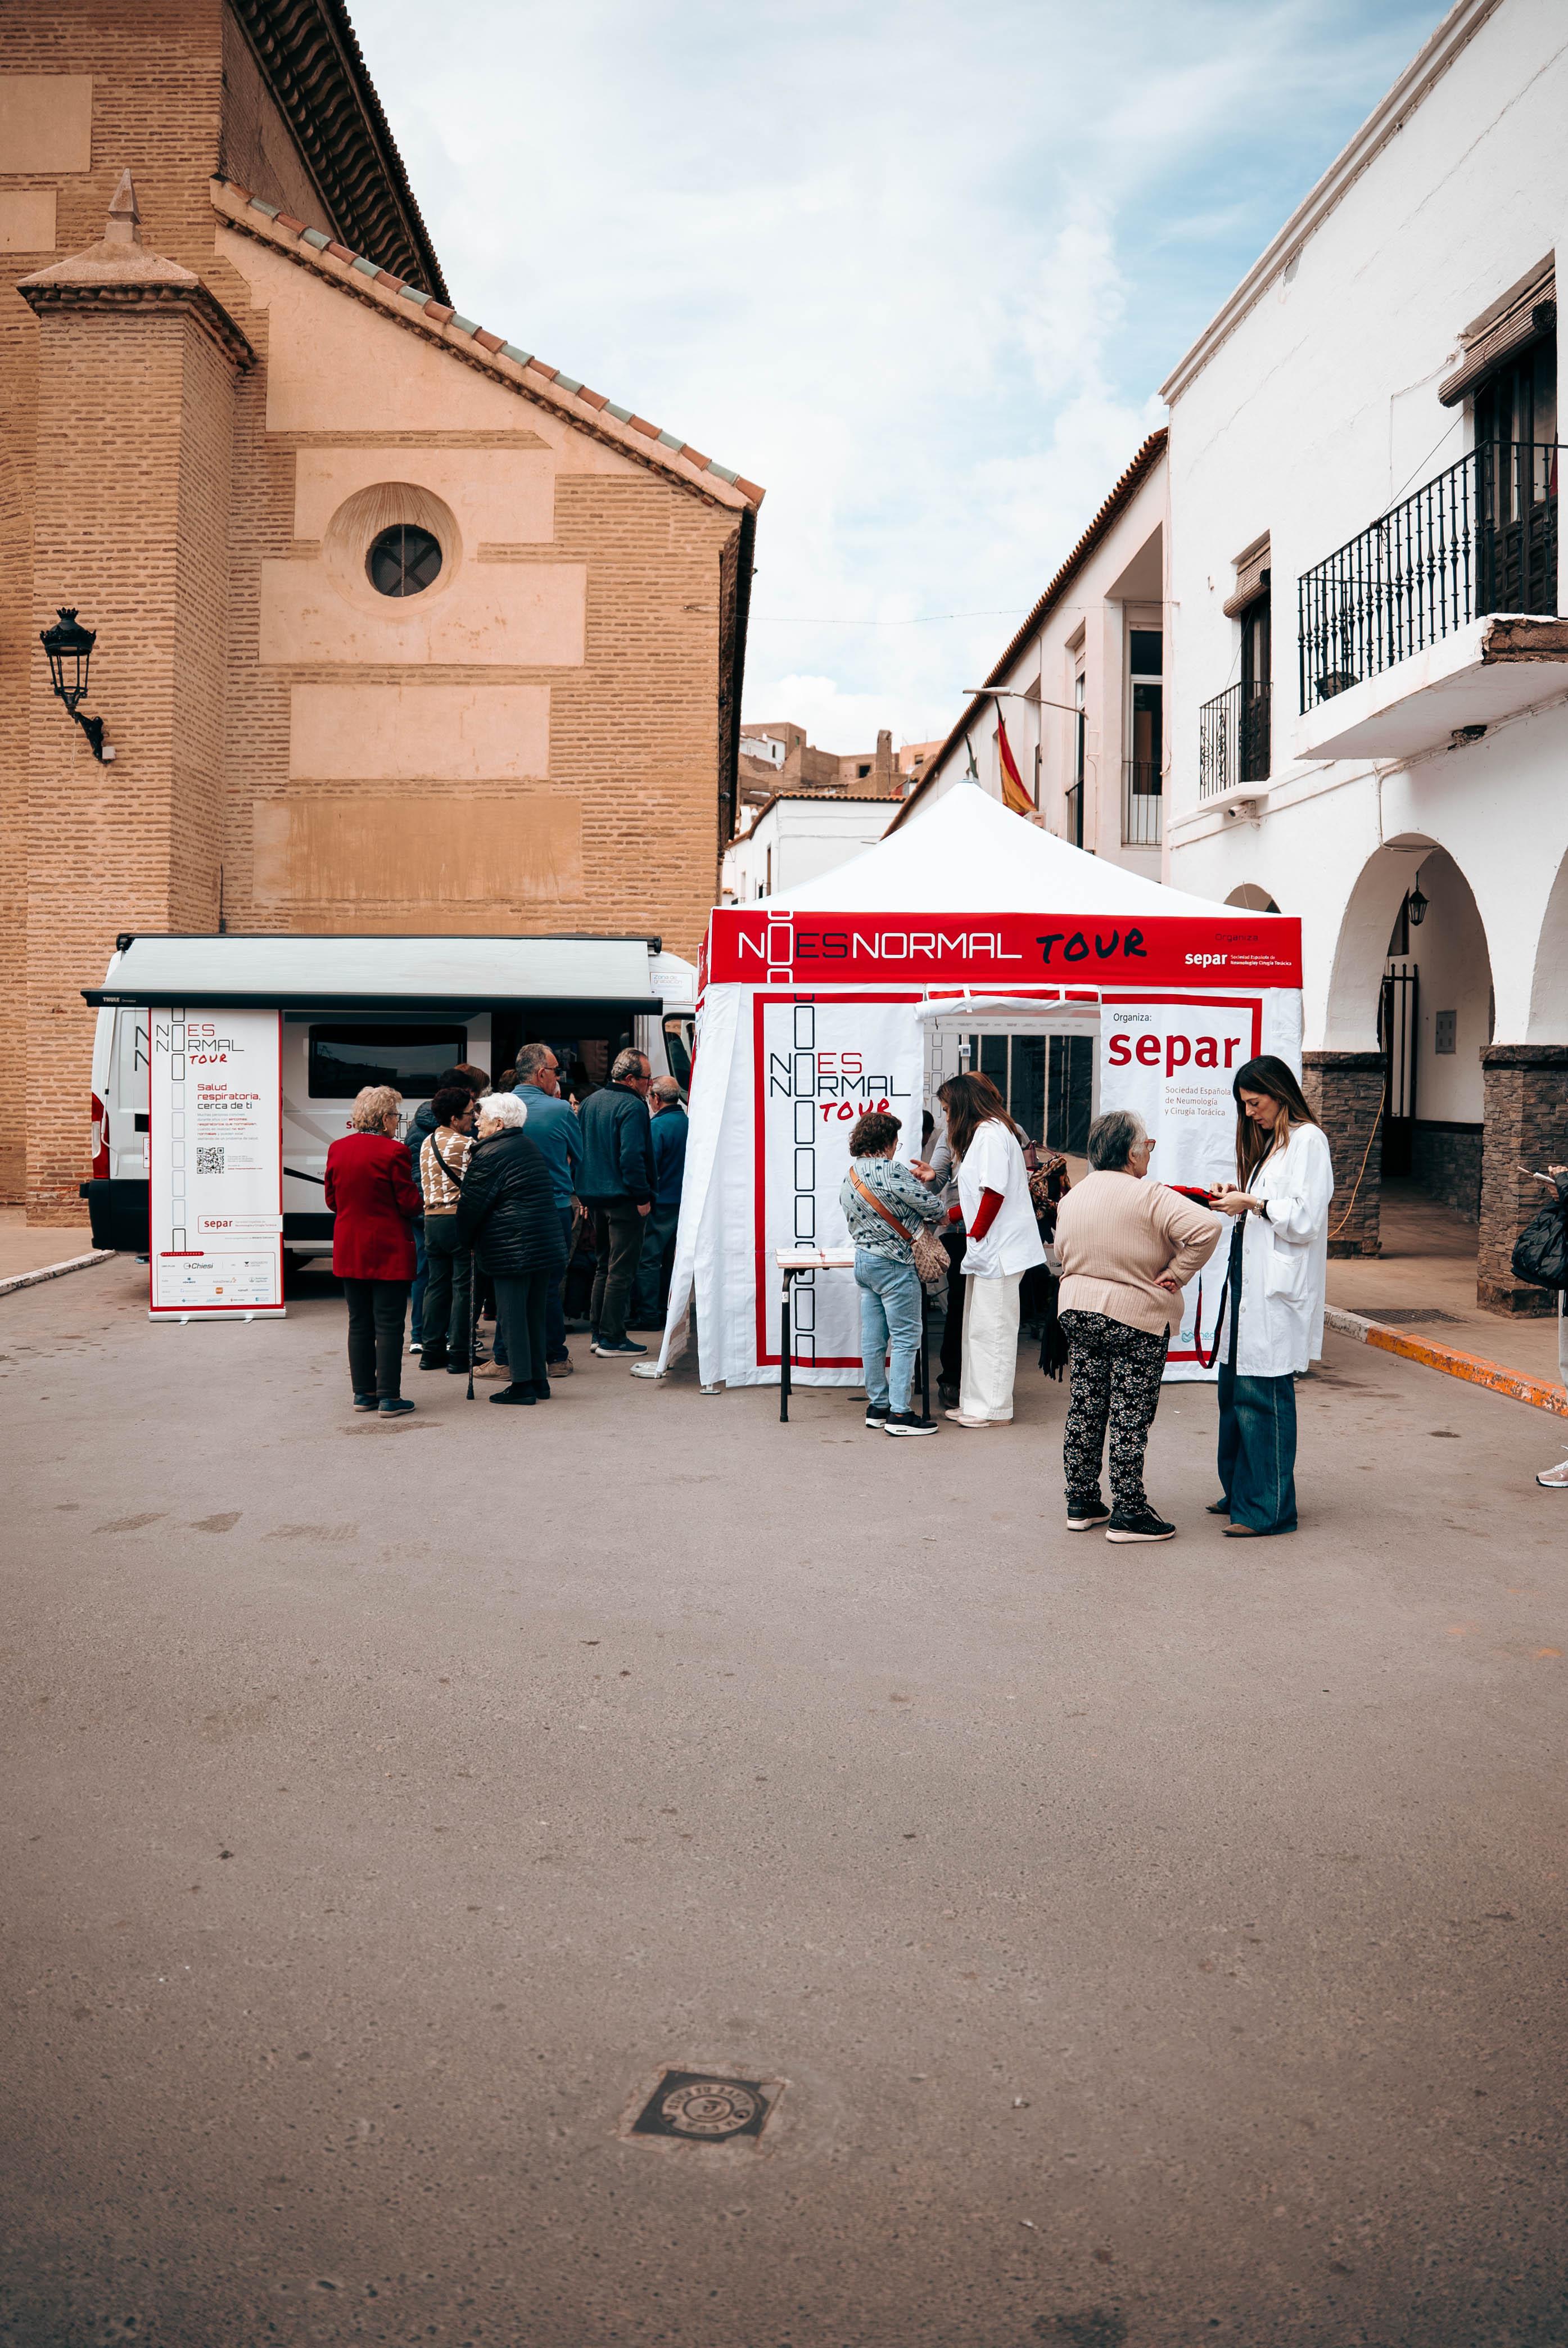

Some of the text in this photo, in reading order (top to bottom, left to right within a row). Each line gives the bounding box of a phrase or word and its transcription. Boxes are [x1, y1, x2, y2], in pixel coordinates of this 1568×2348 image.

[1215, 933, 1259, 942] Organiza
[1036, 927, 1147, 964] TOUR
[1185, 953, 1228, 968] separ
[1113, 1013, 1152, 1023] Organiza:
[188, 1024, 215, 1036] ES
[189, 1053, 228, 1065] TOUR
[1108, 1034, 1241, 1078] separ
[817, 1053, 862, 1074] ES
[197, 1092, 261, 1101] respiratoria,
[1200, 1087, 1231, 1096] Española
[1176, 1097, 1218, 1106] Neumología
[819, 1098, 892, 1122] TOUR
[1170, 1107, 1195, 1116] Cirugía
[1198, 1108, 1226, 1116] Torácica
[204, 1220, 233, 1229] separ
